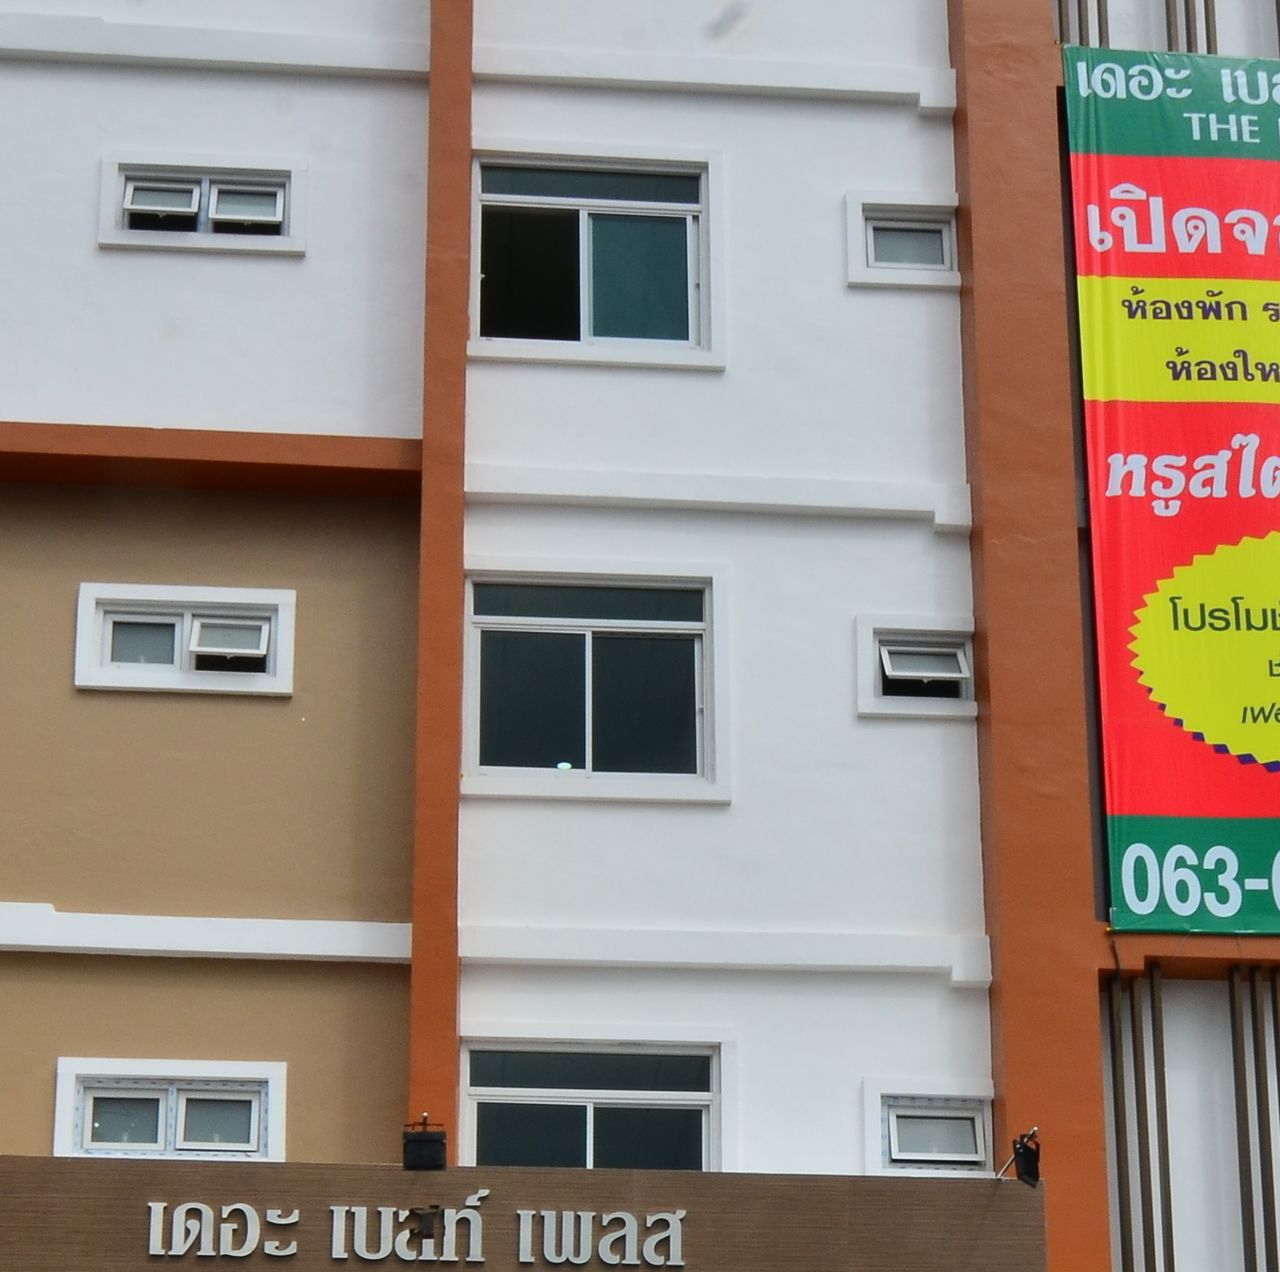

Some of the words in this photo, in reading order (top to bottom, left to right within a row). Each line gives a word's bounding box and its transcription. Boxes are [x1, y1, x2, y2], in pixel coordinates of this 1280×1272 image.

[1077, 58, 1193, 101] เดอะ
[1184, 113, 1260, 144] THE
[1121, 287, 1248, 321] ห้องพัก
[148, 1202, 300, 1257] เดอะ
[517, 1209, 687, 1266] เพลส
